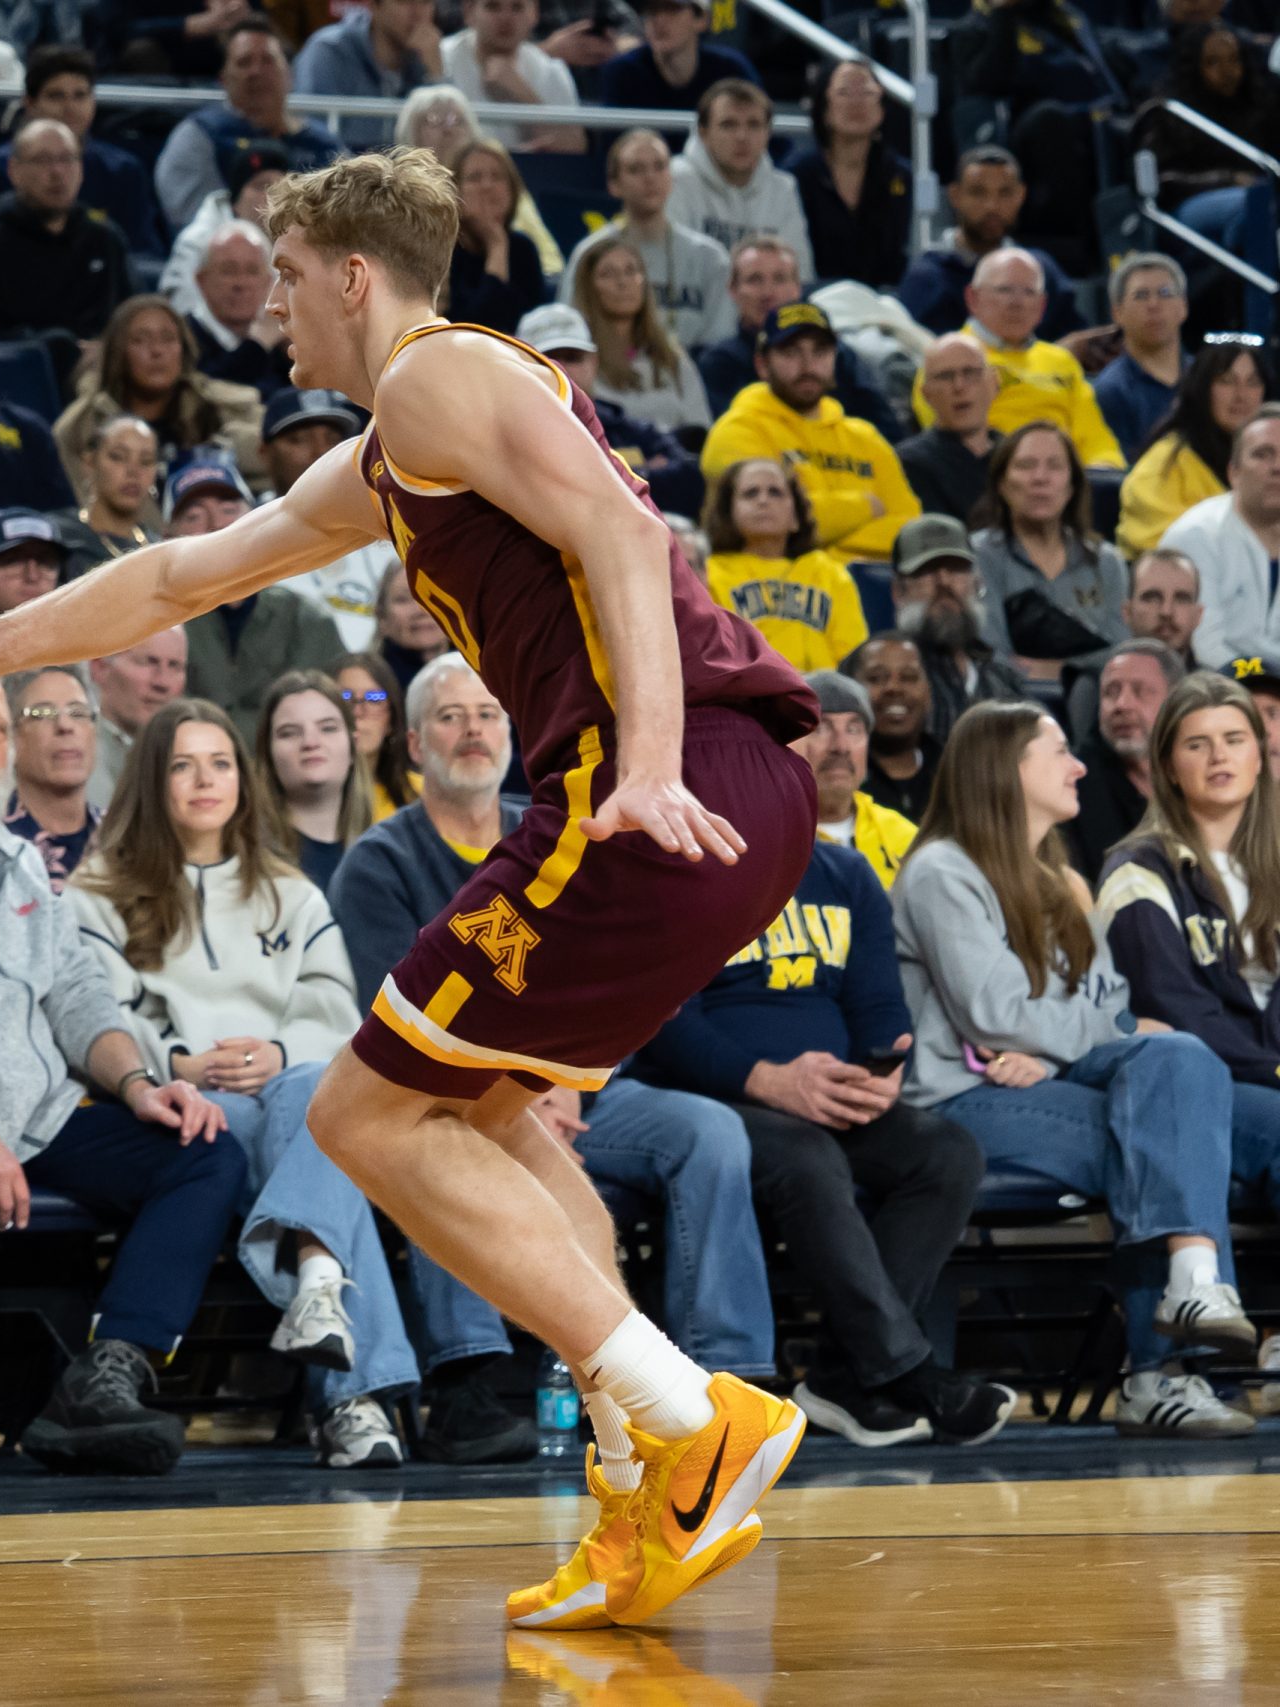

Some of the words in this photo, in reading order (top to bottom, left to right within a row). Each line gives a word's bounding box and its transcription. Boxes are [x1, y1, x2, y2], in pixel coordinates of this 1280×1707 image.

[1232, 656, 1264, 680] M
[256, 928, 290, 957] M
[448, 893, 541, 996] M
[767, 956, 817, 990] M
